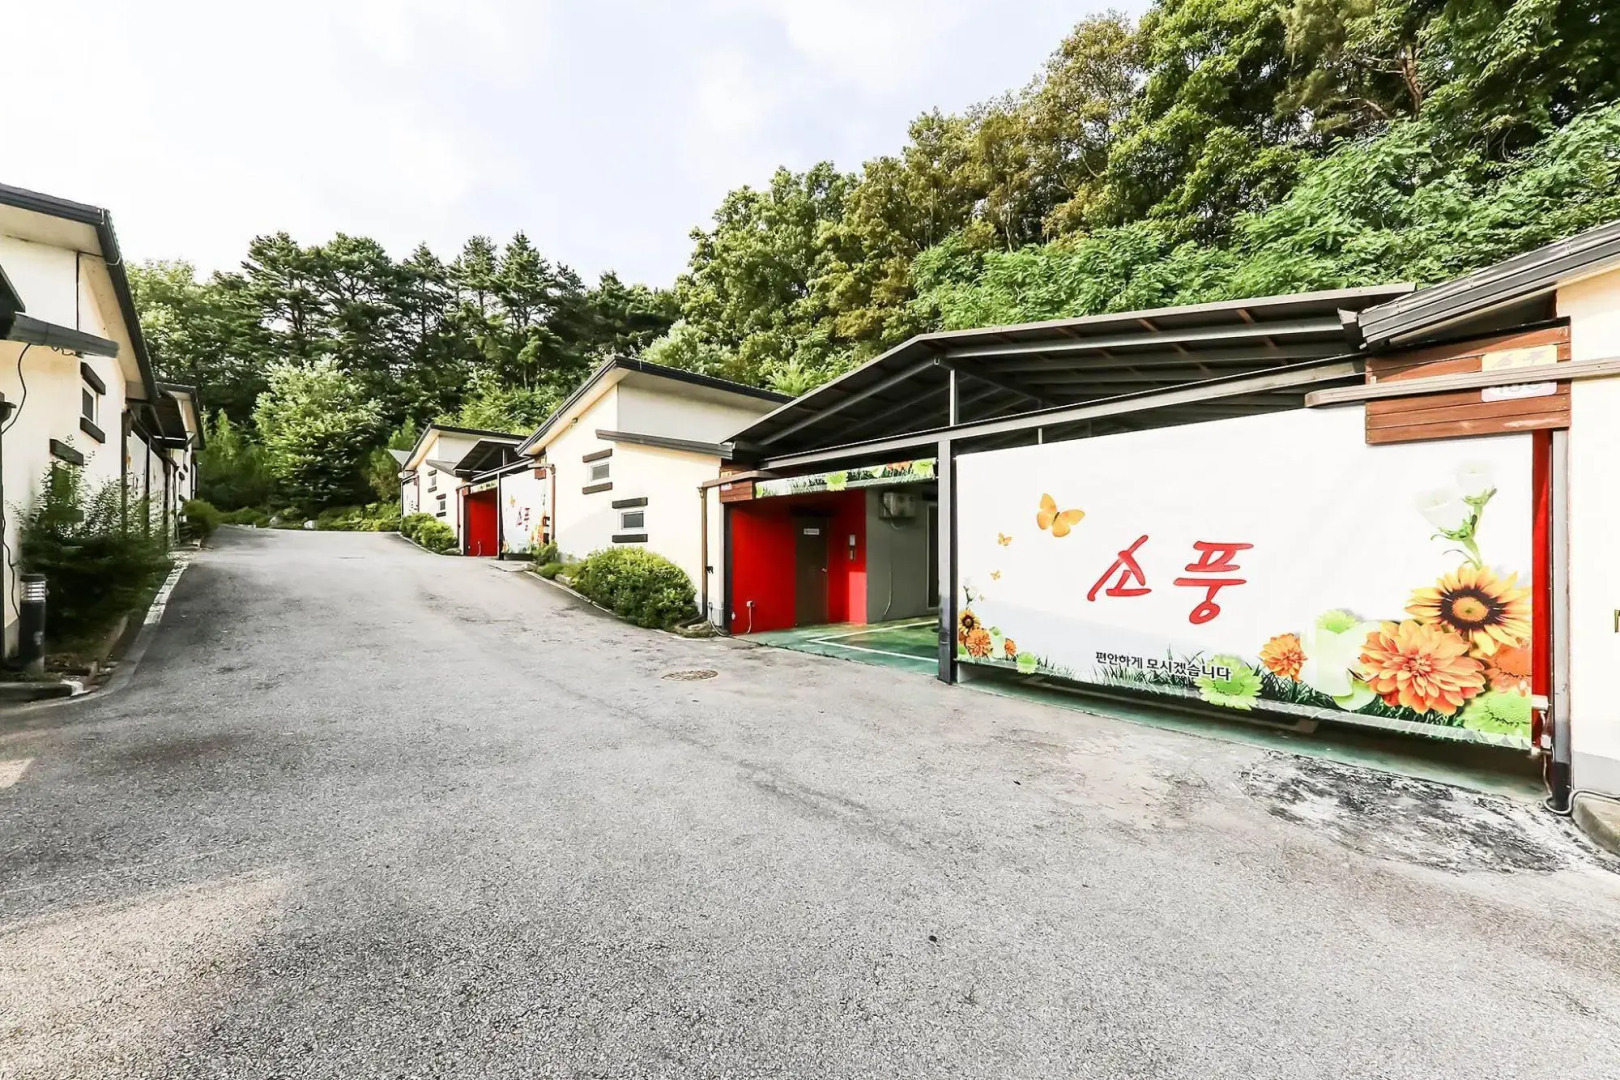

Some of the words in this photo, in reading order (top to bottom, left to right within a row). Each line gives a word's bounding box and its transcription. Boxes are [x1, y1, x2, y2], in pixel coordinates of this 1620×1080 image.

[1087, 534, 1254, 624] 소풍
[1095, 651, 1143, 669] 편안하게
[1146, 658, 1231, 681] 모시겠습니다
